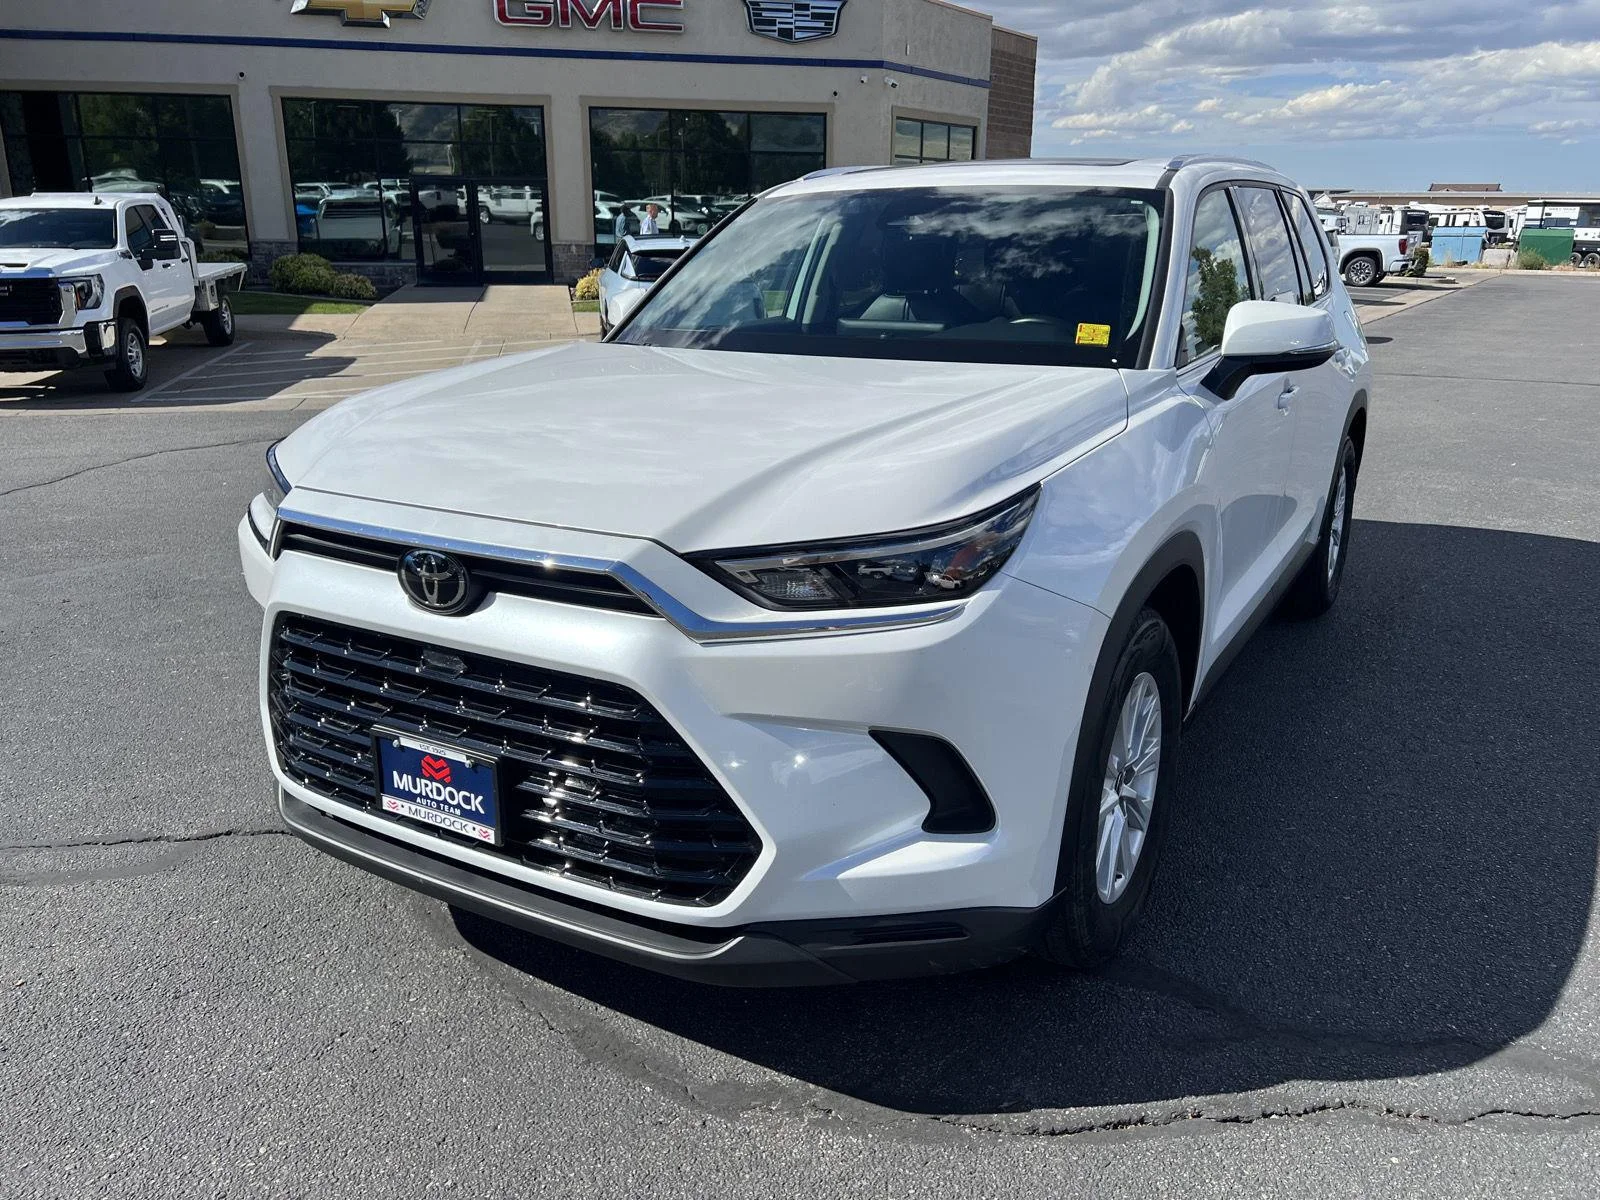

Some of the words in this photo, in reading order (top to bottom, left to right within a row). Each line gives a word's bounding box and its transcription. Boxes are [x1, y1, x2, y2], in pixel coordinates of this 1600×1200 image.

[494, 0, 685, 33] GMC
[392, 770, 485, 815] MURDOCK
[416, 797, 436, 809] AUTO
[440, 803, 461, 816] TEAM
[408, 805, 470, 834] MURDOCK
